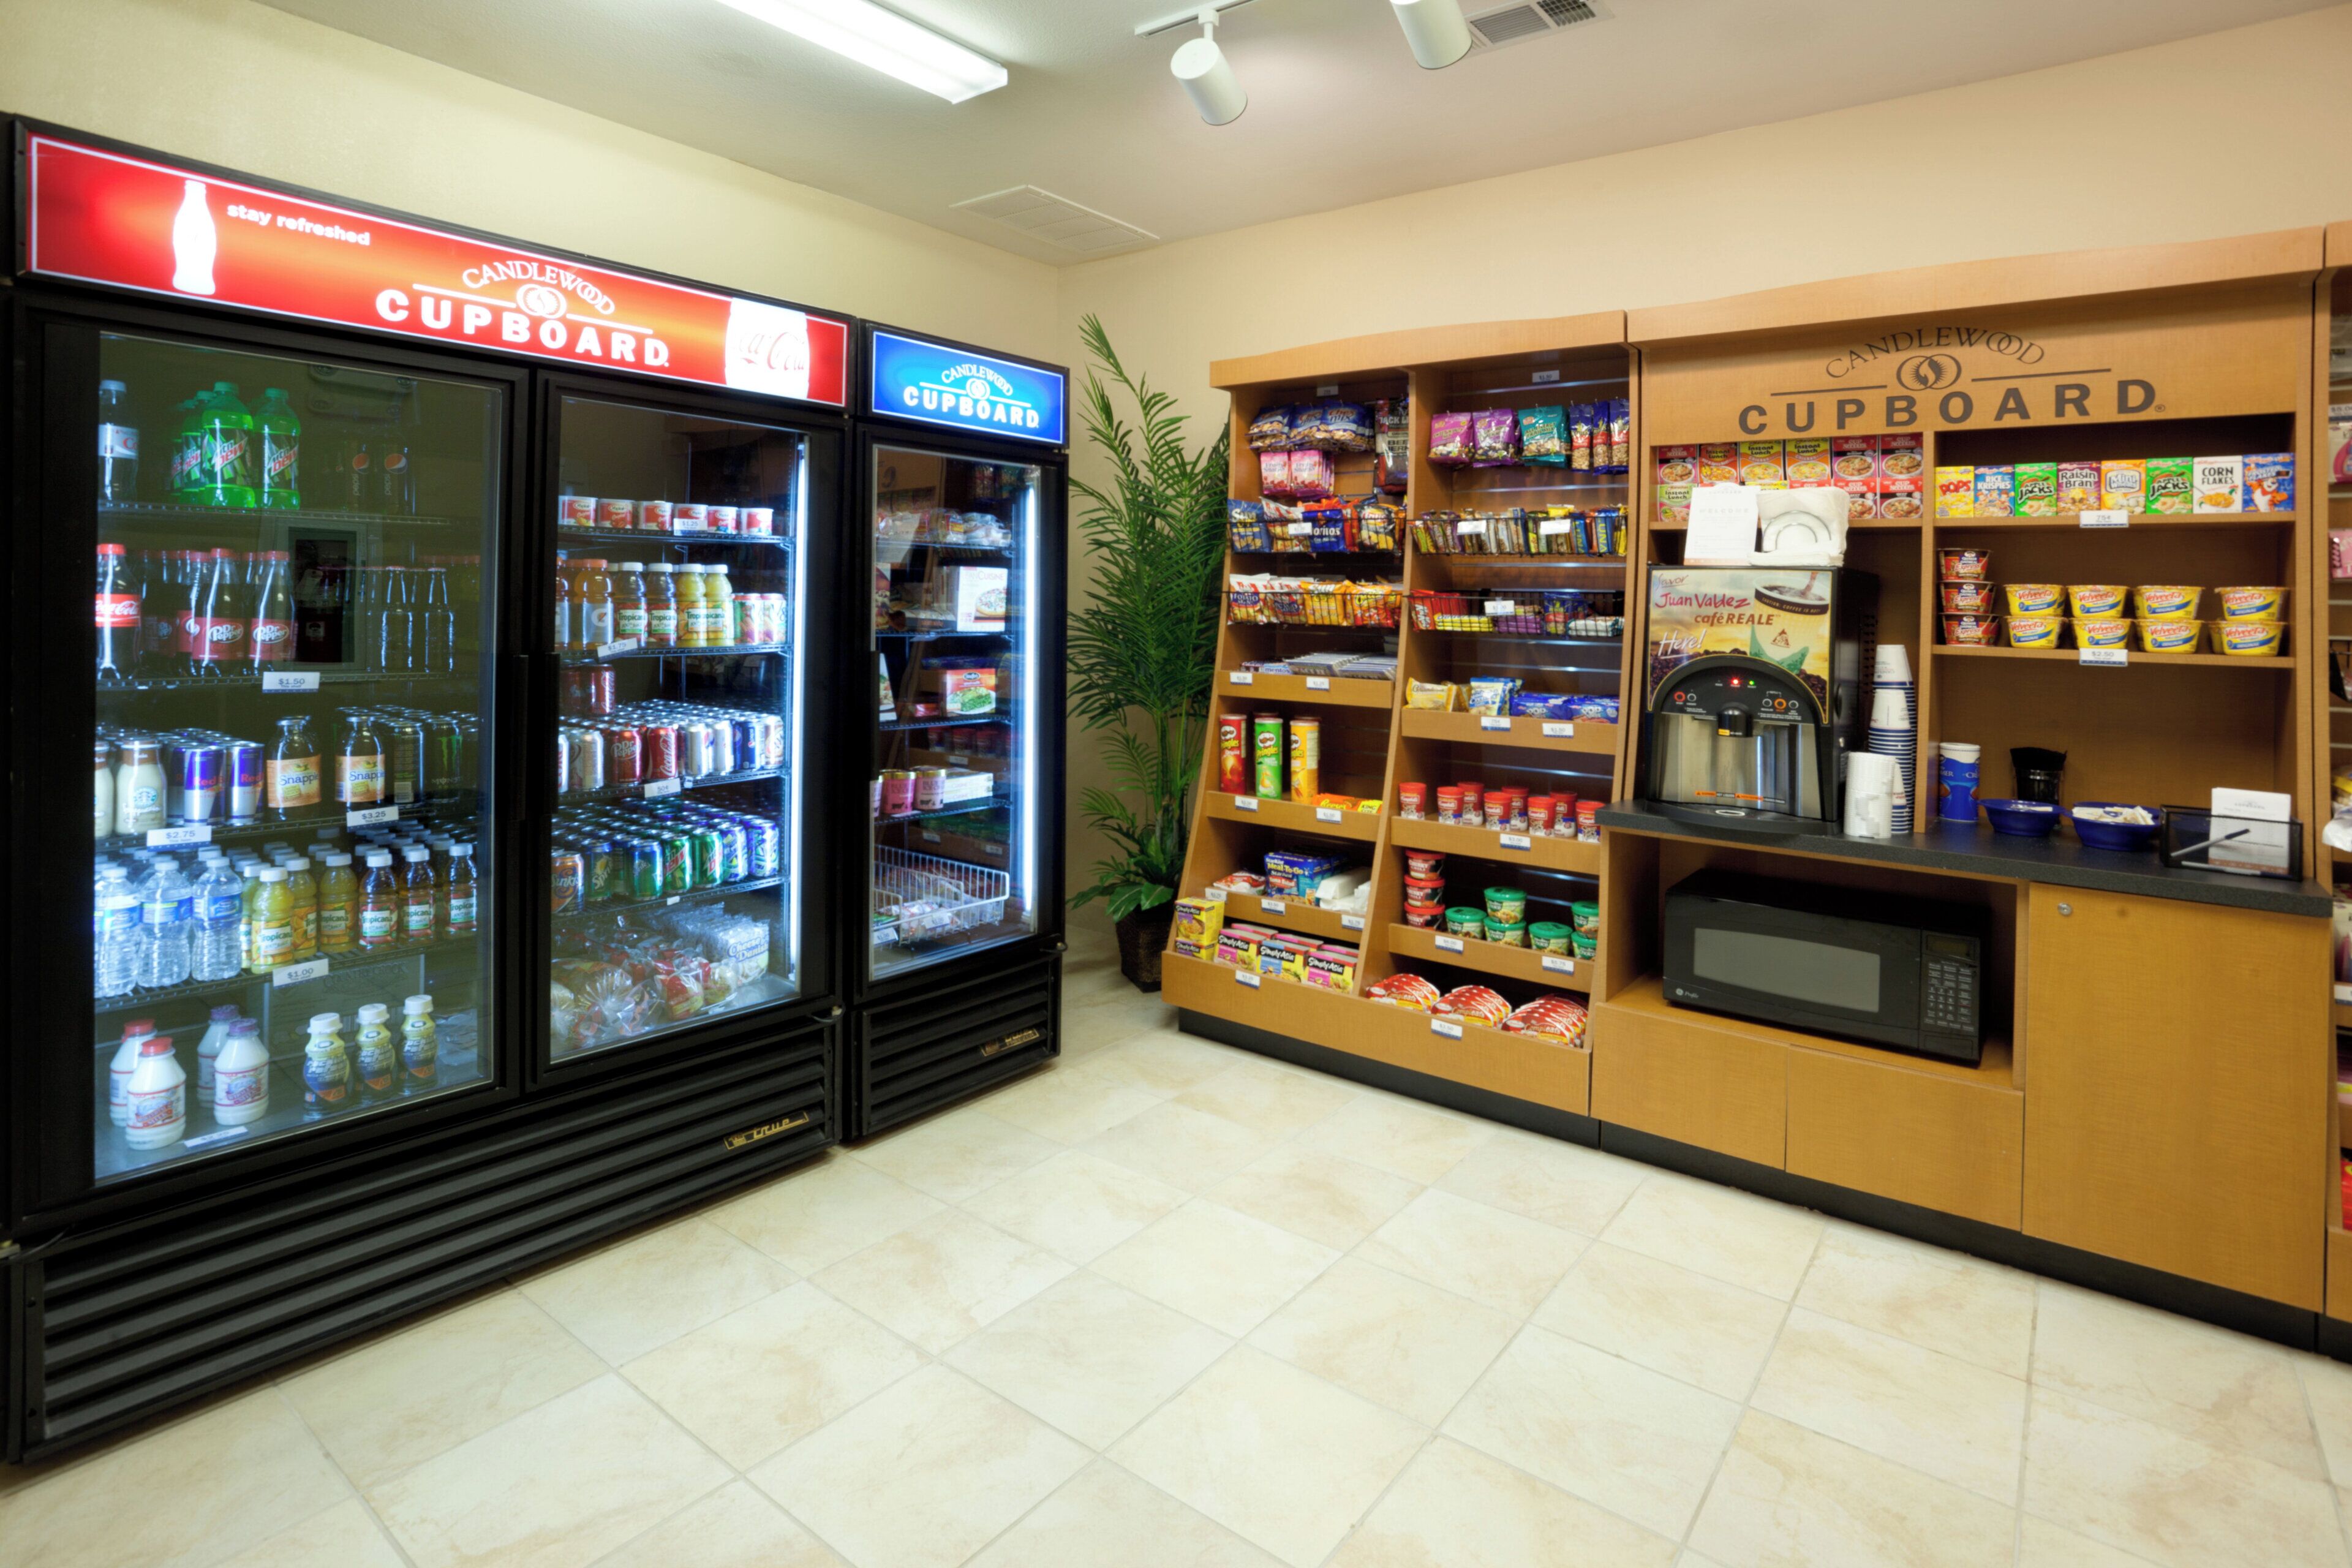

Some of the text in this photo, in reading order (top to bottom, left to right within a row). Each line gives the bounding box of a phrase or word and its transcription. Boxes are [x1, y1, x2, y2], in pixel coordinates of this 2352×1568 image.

[227, 203, 370, 246] stay refreshed
[462, 260, 615, 315] CANDLEWOOD
[375, 288, 669, 367] CUPBOARD
[1826, 327, 2045, 378] CANDLEWOOD
[941, 364, 1013, 396] CANDLEWOOD
[903, 385, 1039, 428] CUPBOARD
[1738, 379, 2155, 434] CUPBOARD
[2060, 471, 2097, 481] Raisin
[2202, 467, 2234, 477] CORN
[1977, 481, 2011, 490] KRISPIES
[2065, 479, 2093, 489] Bran
[2202, 476, 2234, 485] FLAKES
[1939, 480, 1972, 497] POPS
[2019, 486, 2052, 502] JACKS
[2150, 482, 2188, 498] JACKS
[1311, 526, 1341, 535] oritos
[1655, 573, 1689, 592] Savor
[1655, 593, 1751, 609] Juan Valdez
[2018, 589, 2053, 601] Velveeta
[2078, 591, 2114, 602] Velveeta
[2145, 591, 2182, 601] Velveeta
[2224, 593, 2264, 603] Velveeta
[1694, 612, 1774, 627] café REALE
[2011, 621, 2044, 631] Velveeta
[2087, 624, 2124, 635] Velveeta
[2149, 625, 2190, 636] Velveeta
[2225, 627, 2265, 638] Velveeta
[608, 641, 627, 651] $1.75
[1657, 628, 1707, 657] Here!
[278, 677, 305, 686] $1.50
[1256, 746, 1278, 758] Pringles
[279, 772, 320, 786] Snapple
[349, 769, 385, 782] Snapple
[361, 811, 386, 820] $3.25
[165, 830, 196, 839] $2.75
[728, 938, 762, 957] Cheese
[1218, 935, 1249, 951] Simply Asia
[1260, 946, 1294, 961] Simply Asia
[1308, 957, 1343, 973] Simply Asia
[287, 968, 314, 979] $1.00
[753, 1118, 790, 1139] true
